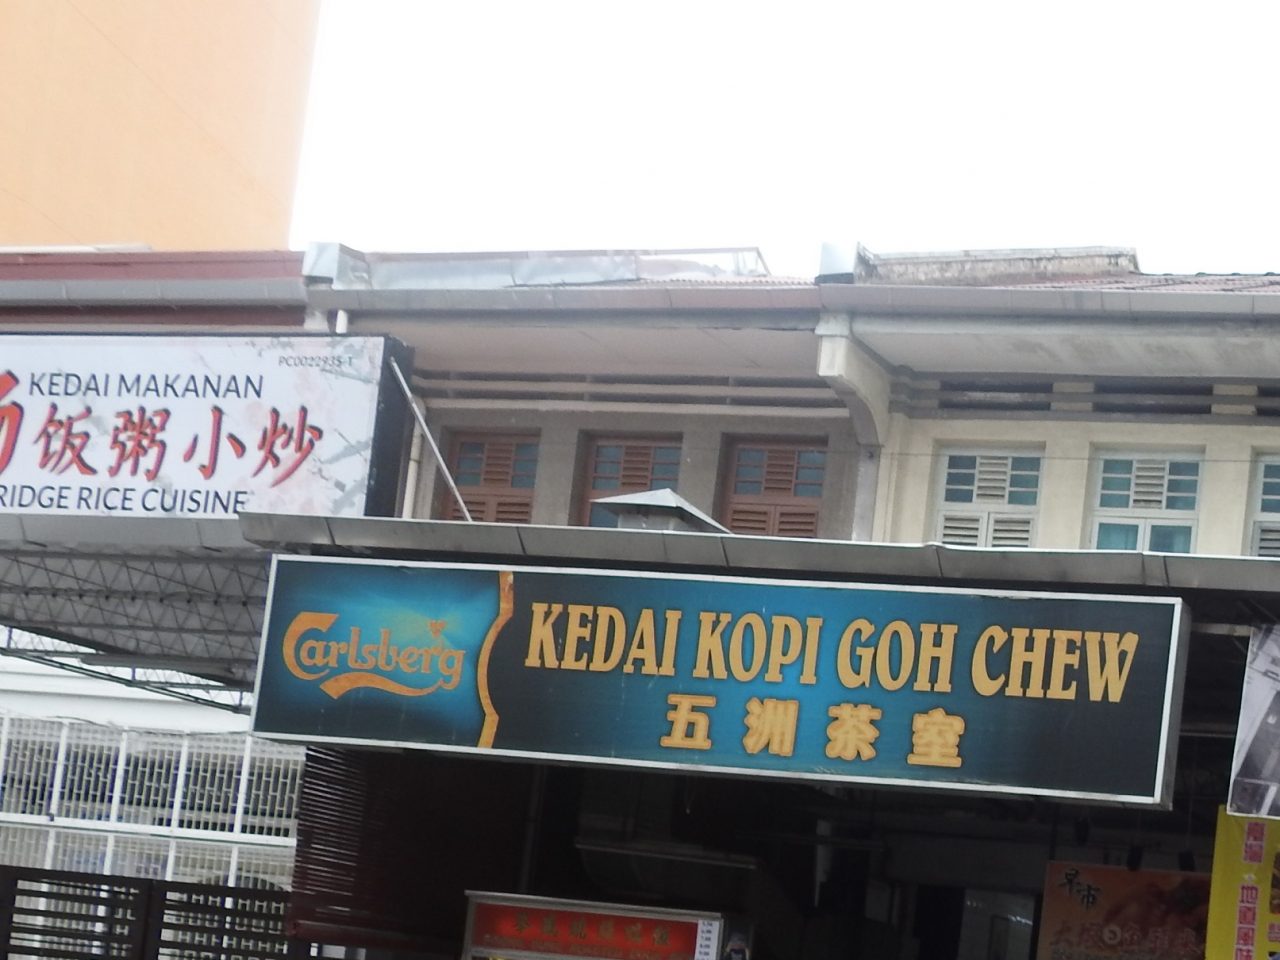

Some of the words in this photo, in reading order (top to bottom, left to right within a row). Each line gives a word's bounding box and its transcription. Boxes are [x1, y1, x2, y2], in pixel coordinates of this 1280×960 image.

[29, 372, 110, 398] KEDAI
[117, 373, 264, 400] MAKANAN
[33, 402, 324, 488] 饭粥小炒
[0, 484, 72, 509] RIDGE
[78, 486, 137, 511] RICE
[141, 488, 249, 514] CUISINE
[282, 611, 467, 692] Carlsberg
[525, 602, 682, 677] KEDAI
[692, 610, 824, 685] KOPI
[836, 618, 959, 693] GOH
[970, 624, 1140, 703] CHEW
[660, 693, 966, 769] 五洲茶室
